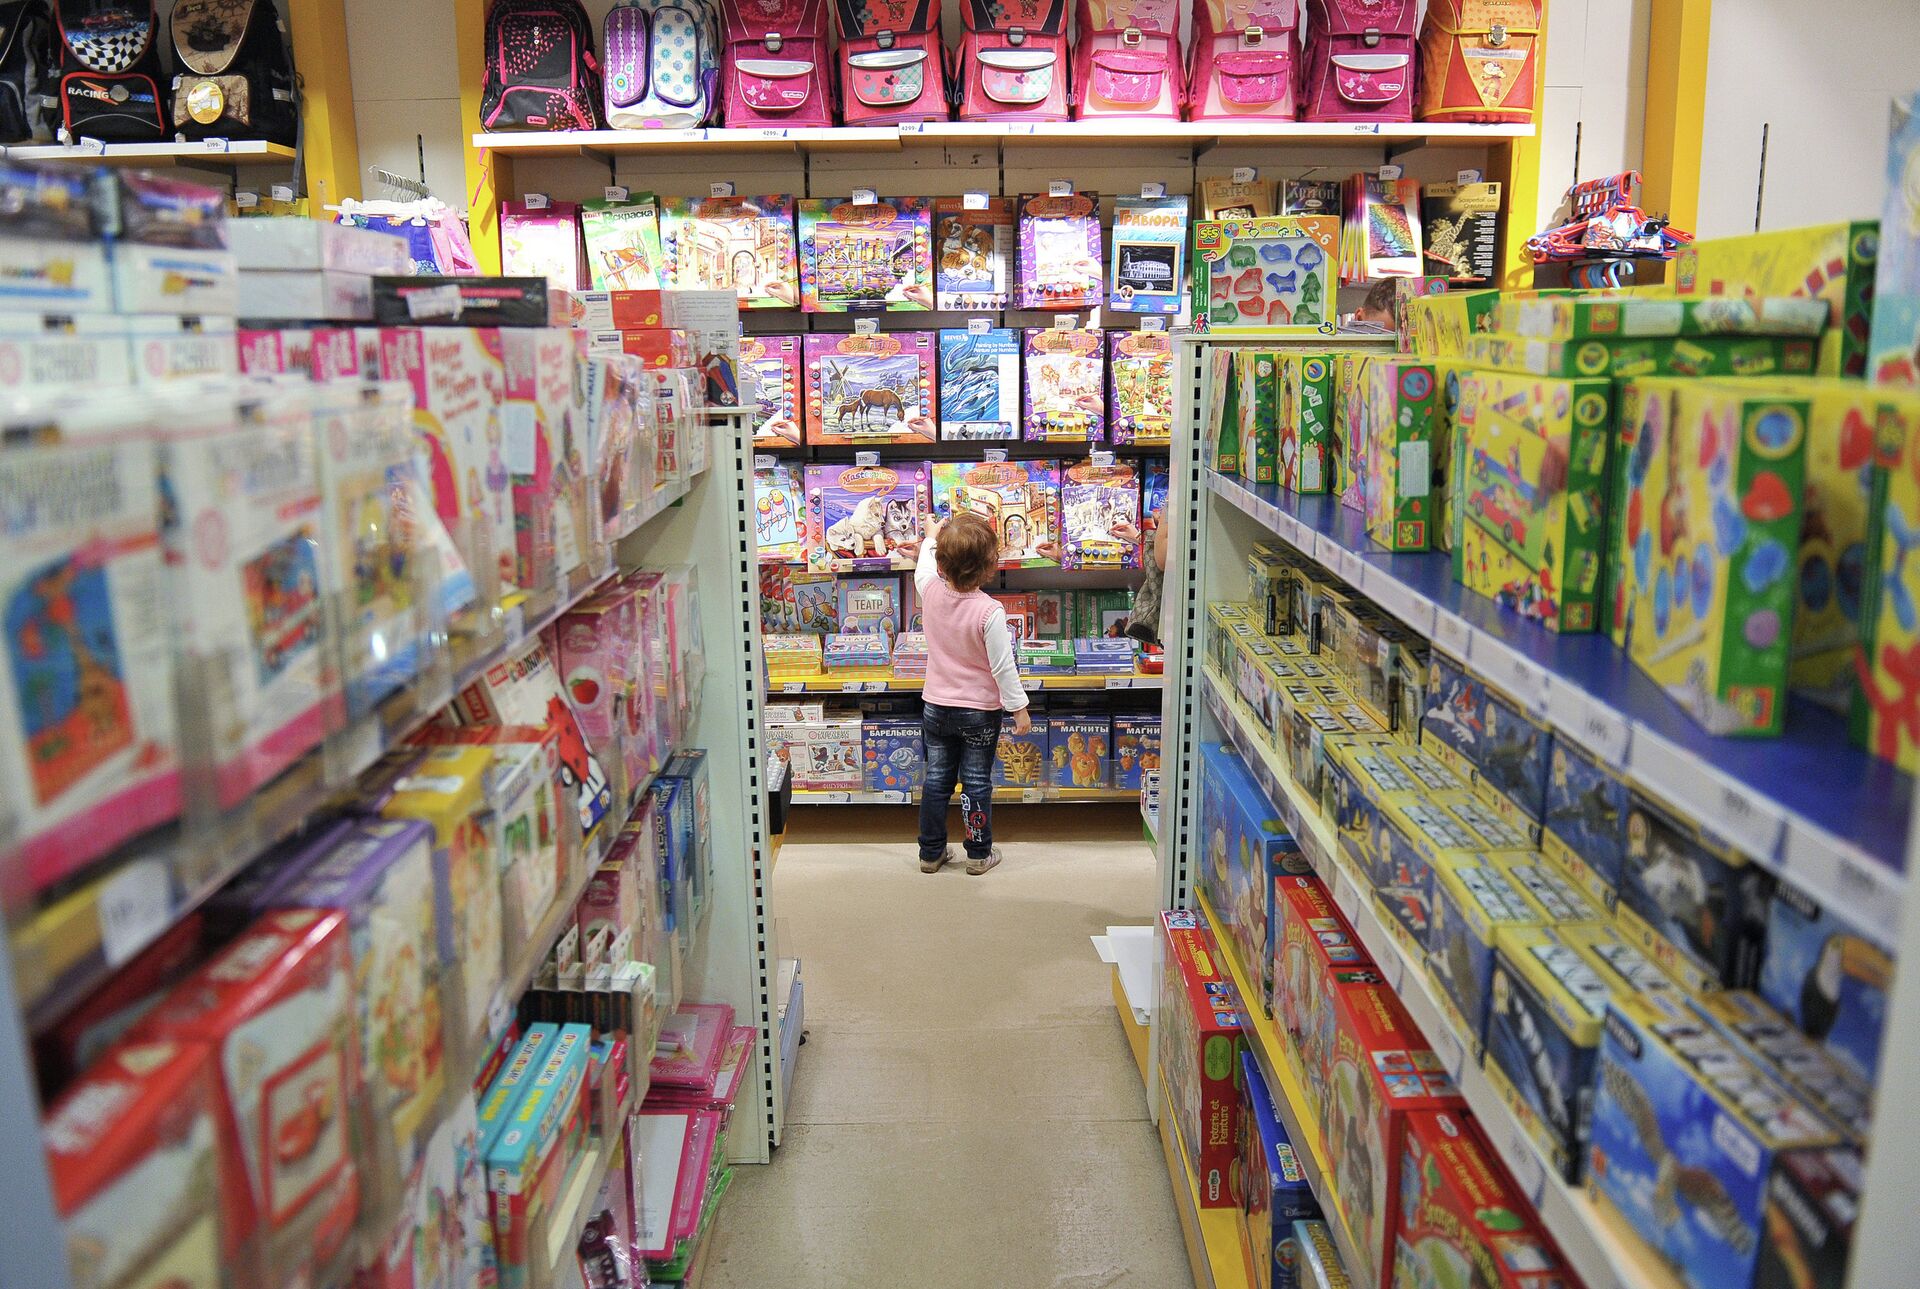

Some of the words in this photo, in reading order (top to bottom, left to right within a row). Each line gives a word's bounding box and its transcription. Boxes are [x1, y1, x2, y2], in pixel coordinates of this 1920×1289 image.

[68, 87, 110, 99] RACING
[1119, 209, 1180, 227] ГРАВЮРА
[1199, 226, 1220, 239] SES
[1308, 221, 1332, 245] 2-6
[854, 599, 883, 611] ТЕАТР
[870, 729, 922, 737] БАРЕЛЬЕФЫ
[1061, 725, 1109, 733] МАГНИТЫ
[1127, 727, 1161, 735] МАГНИ
